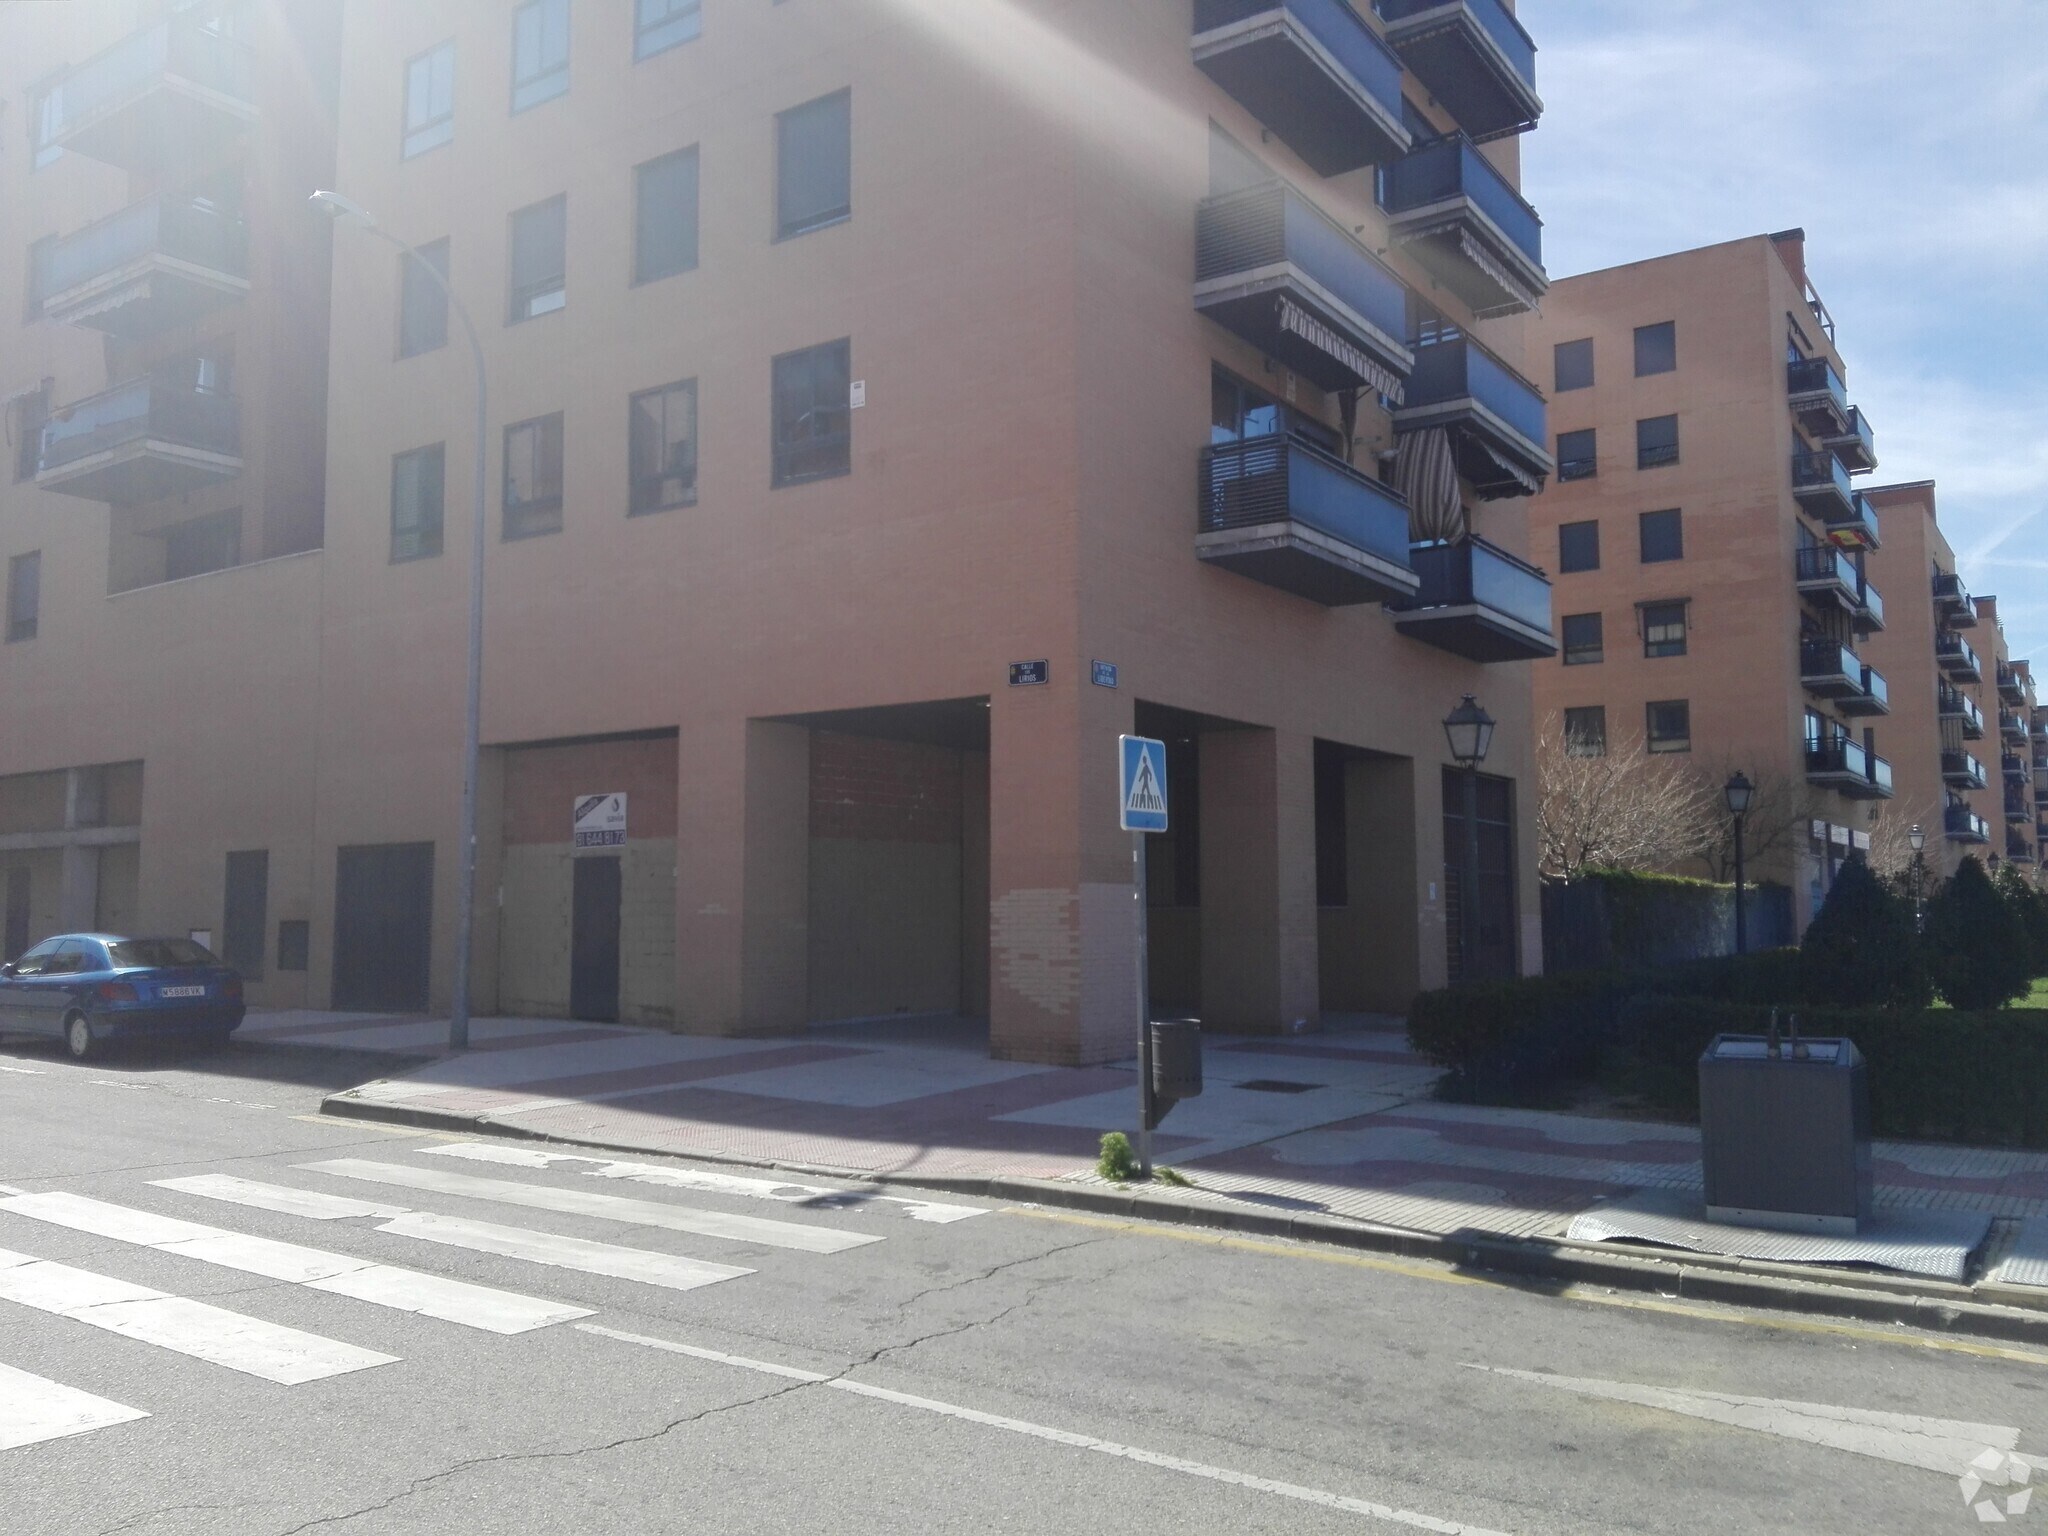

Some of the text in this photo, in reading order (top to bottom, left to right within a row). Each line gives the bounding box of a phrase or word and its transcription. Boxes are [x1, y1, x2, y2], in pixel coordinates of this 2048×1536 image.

[1019, 674, 1036, 682] LIRIOS
[586, 832, 602, 845] 644
[614, 830, 625, 844] 73
